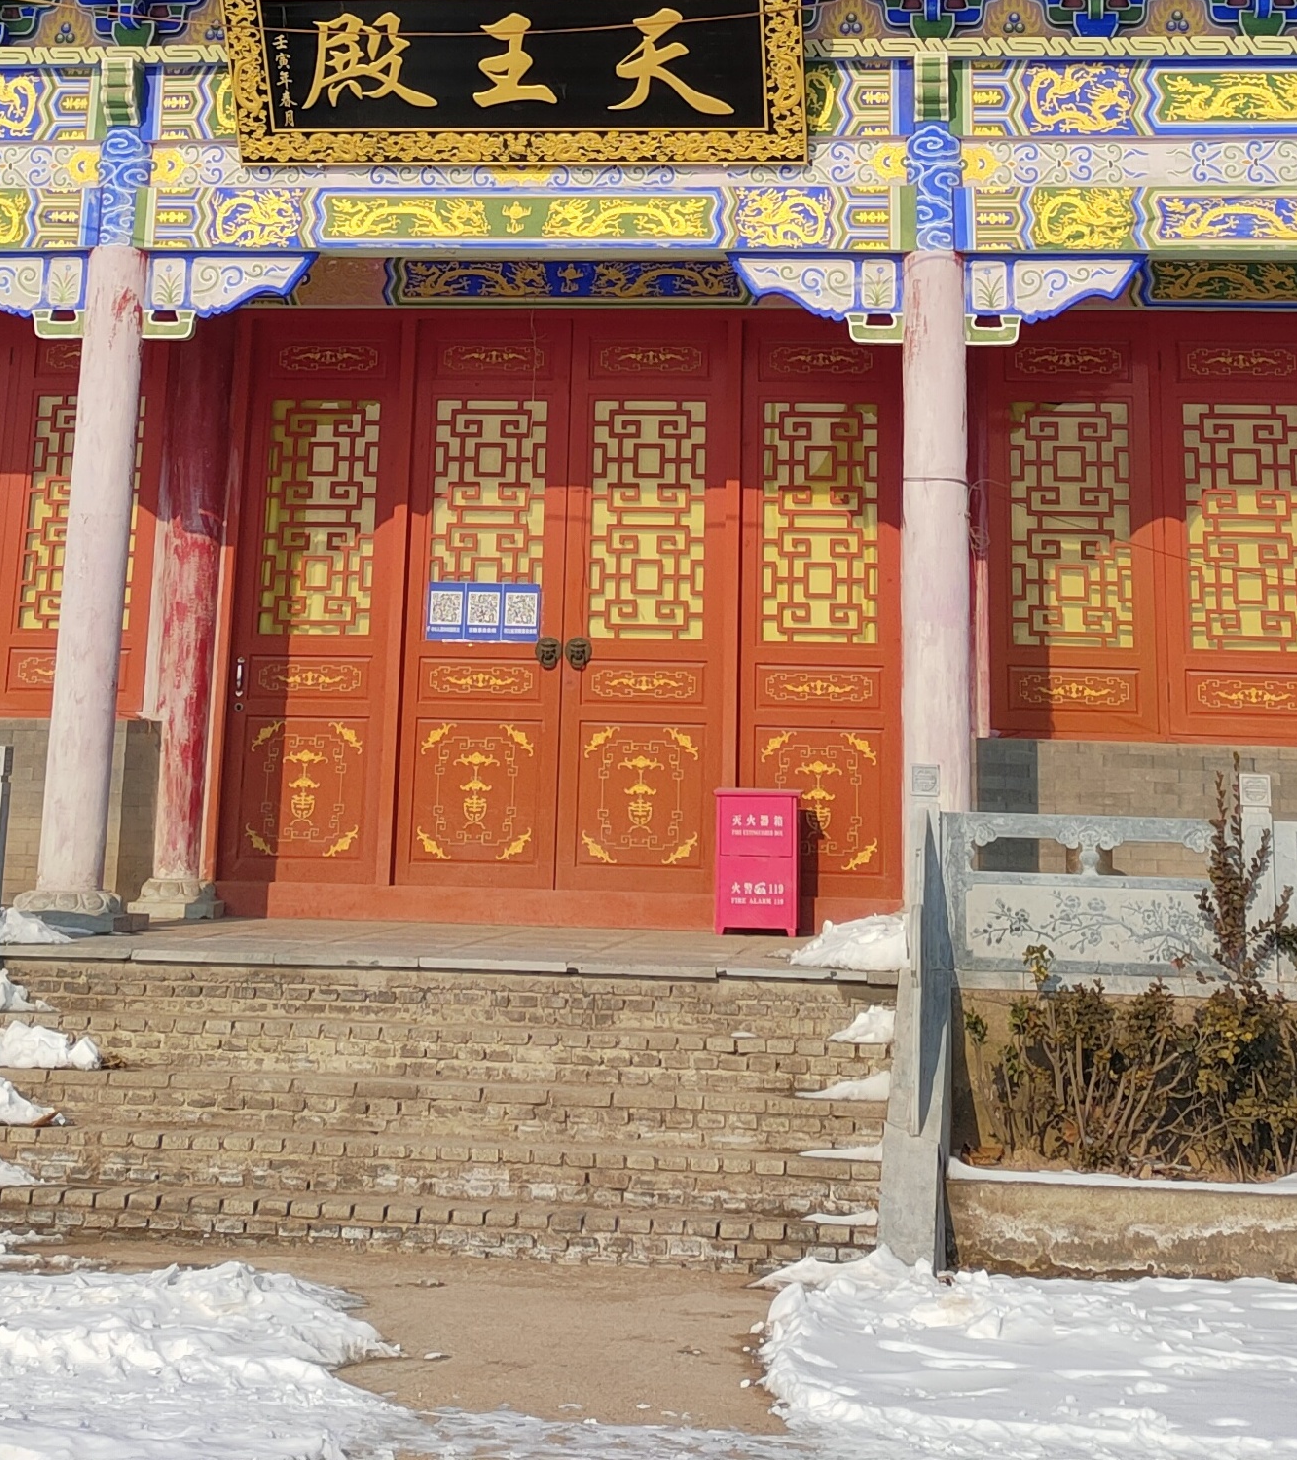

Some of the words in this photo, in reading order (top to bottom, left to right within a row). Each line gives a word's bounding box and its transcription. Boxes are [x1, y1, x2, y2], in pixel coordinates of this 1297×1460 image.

[272, 34, 298, 128] 壬寅年春月
[301, 7, 735, 116] 天王殿
[732, 814, 783, 827] 灭火器箱
[731, 881, 752, 895] 火警
[768, 883, 784, 895] 119
